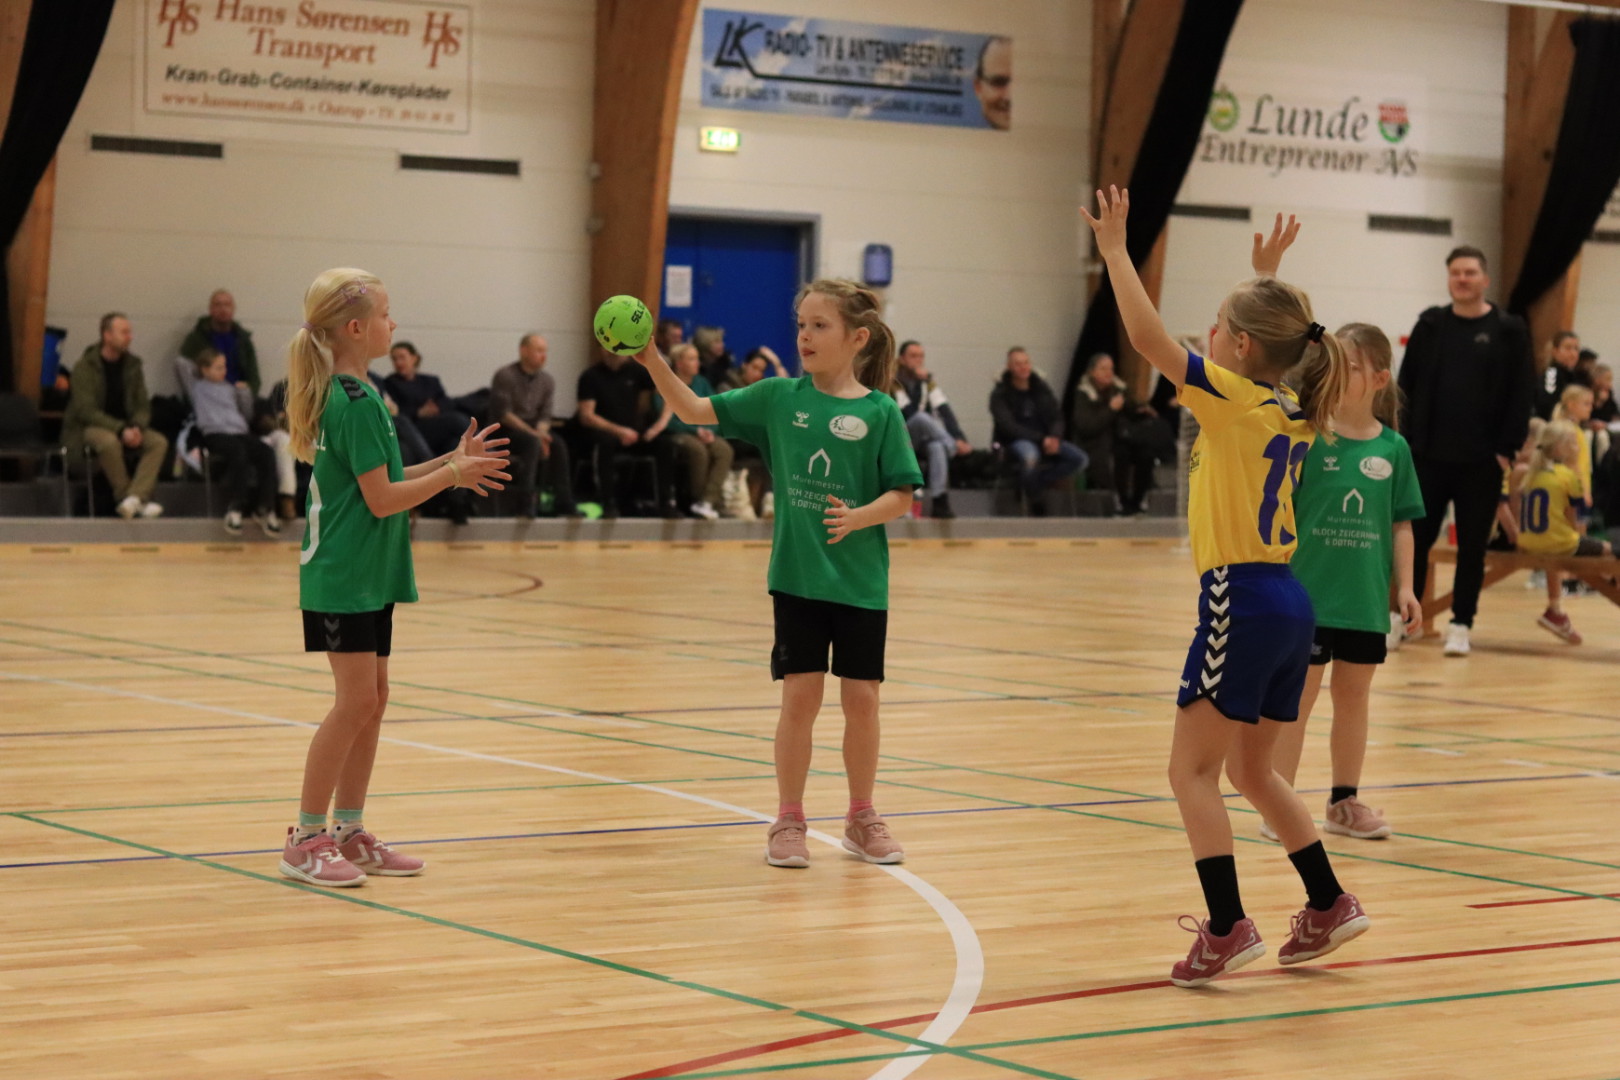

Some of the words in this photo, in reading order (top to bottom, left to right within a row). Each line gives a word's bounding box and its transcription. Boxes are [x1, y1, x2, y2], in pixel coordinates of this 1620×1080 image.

[215, 0, 287, 25] Hans
[296, 0, 410, 36] Sørensen
[248, 26, 376, 69] Transport
[1246, 93, 1369, 142] Lunde
[1520, 488, 1549, 534] 10
